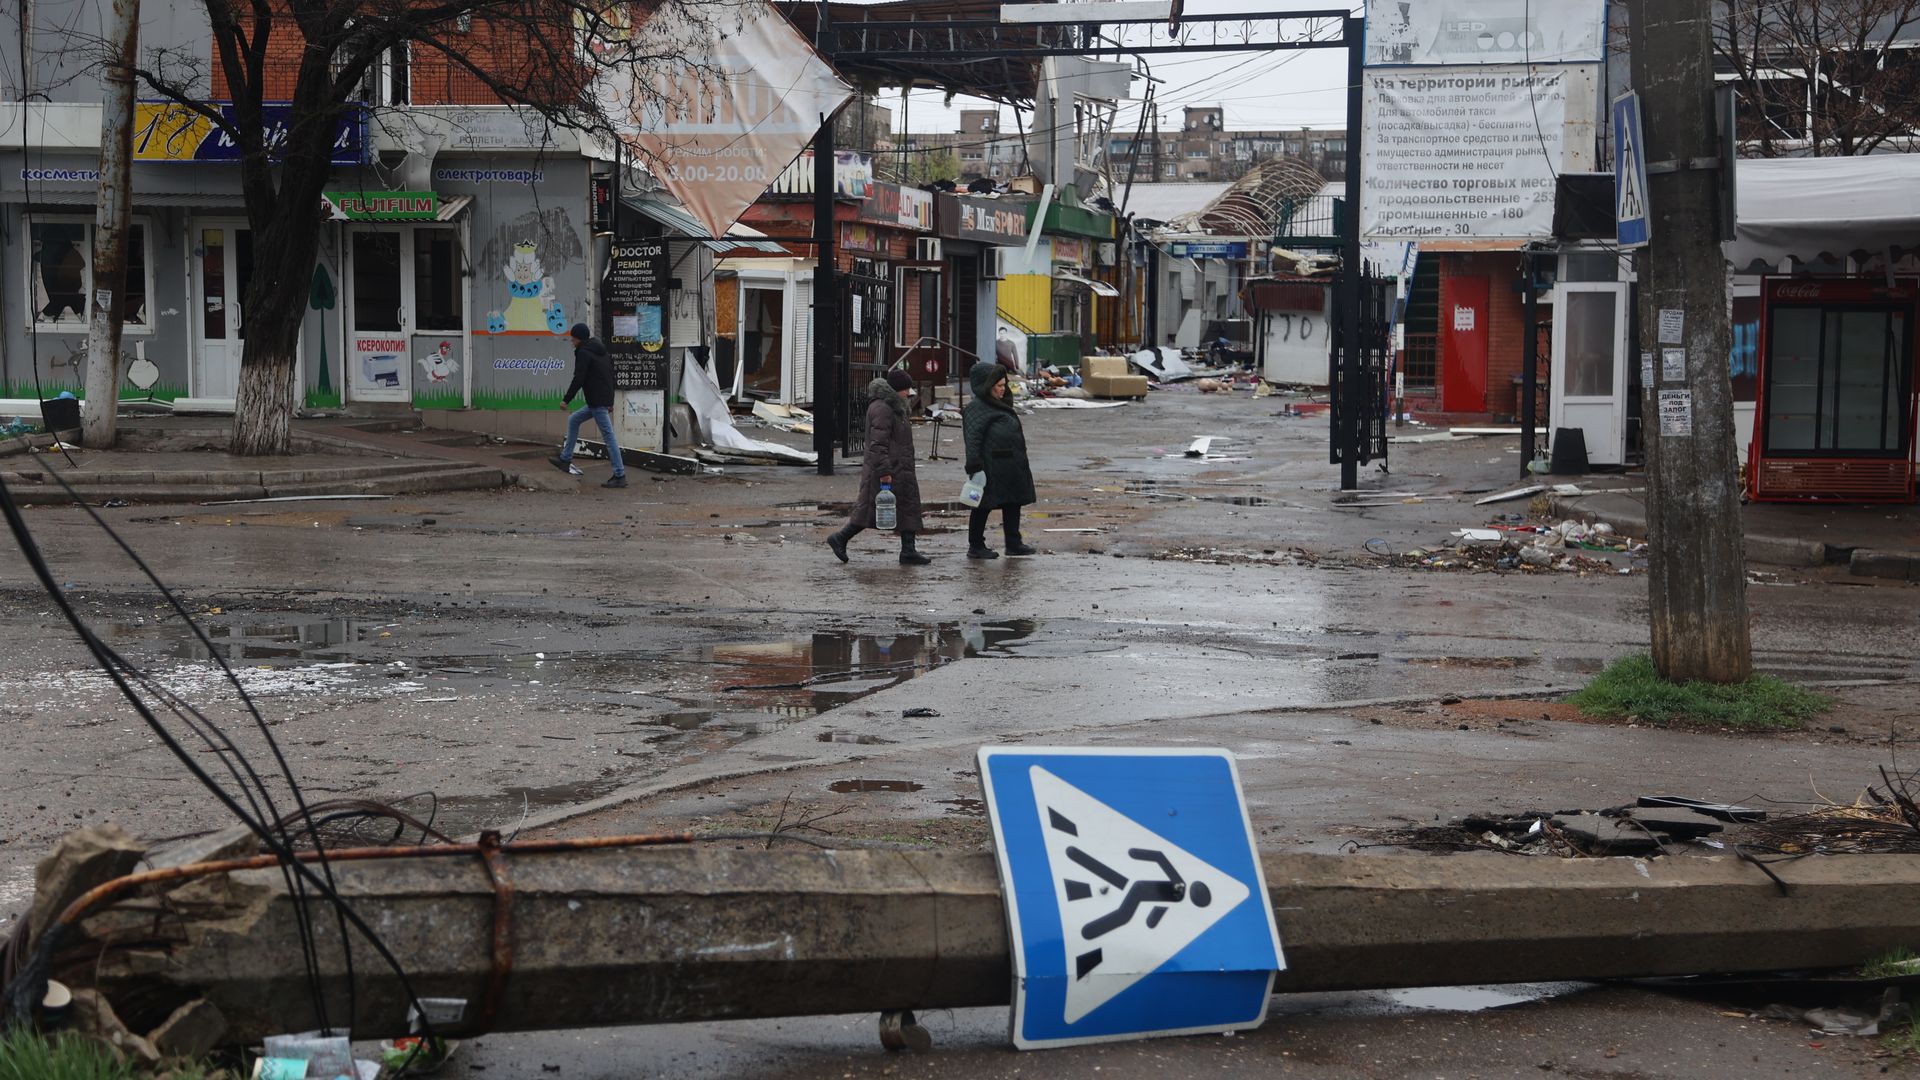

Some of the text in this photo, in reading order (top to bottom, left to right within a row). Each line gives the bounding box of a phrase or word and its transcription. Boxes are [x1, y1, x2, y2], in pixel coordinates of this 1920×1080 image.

[1447, 22, 1487, 32] LED
[1400, 77, 1496, 92] территории
[1378, 93, 1424, 105] Паровка
[1378, 105, 1496, 118] Для автомобилей такси
[1478, 120, 1532, 130] бесплатно
[1377, 133, 1389, 144] За
[1392, 135, 1460, 146] транспортное
[1463, 134, 1509, 145] средство
[1376, 147, 1547, 159] имущество администрация рынка
[1376, 161, 1505, 170] ответственности не несет
[21, 169, 101, 181] космети
[437, 169, 544, 184] електротовары
[1368, 176, 1448, 189] Количество
[1452, 178, 1517, 191] торговых
[1379, 194, 1520, 206] продовольственные
[1533, 191, 1555, 203] 253
[339, 198, 433, 213] FUJIFILM
[1503, 207, 1524, 219] 180
[1377, 225, 1442, 237] льготные
[1455, 223, 1470, 235] 30
[620, 246, 662, 257] DOCTOR
[617, 260, 651, 269] РЕМОНТ
[357, 340, 406, 352] КСЕРОКОПИЯ
[494, 357, 565, 375] аксессуары
